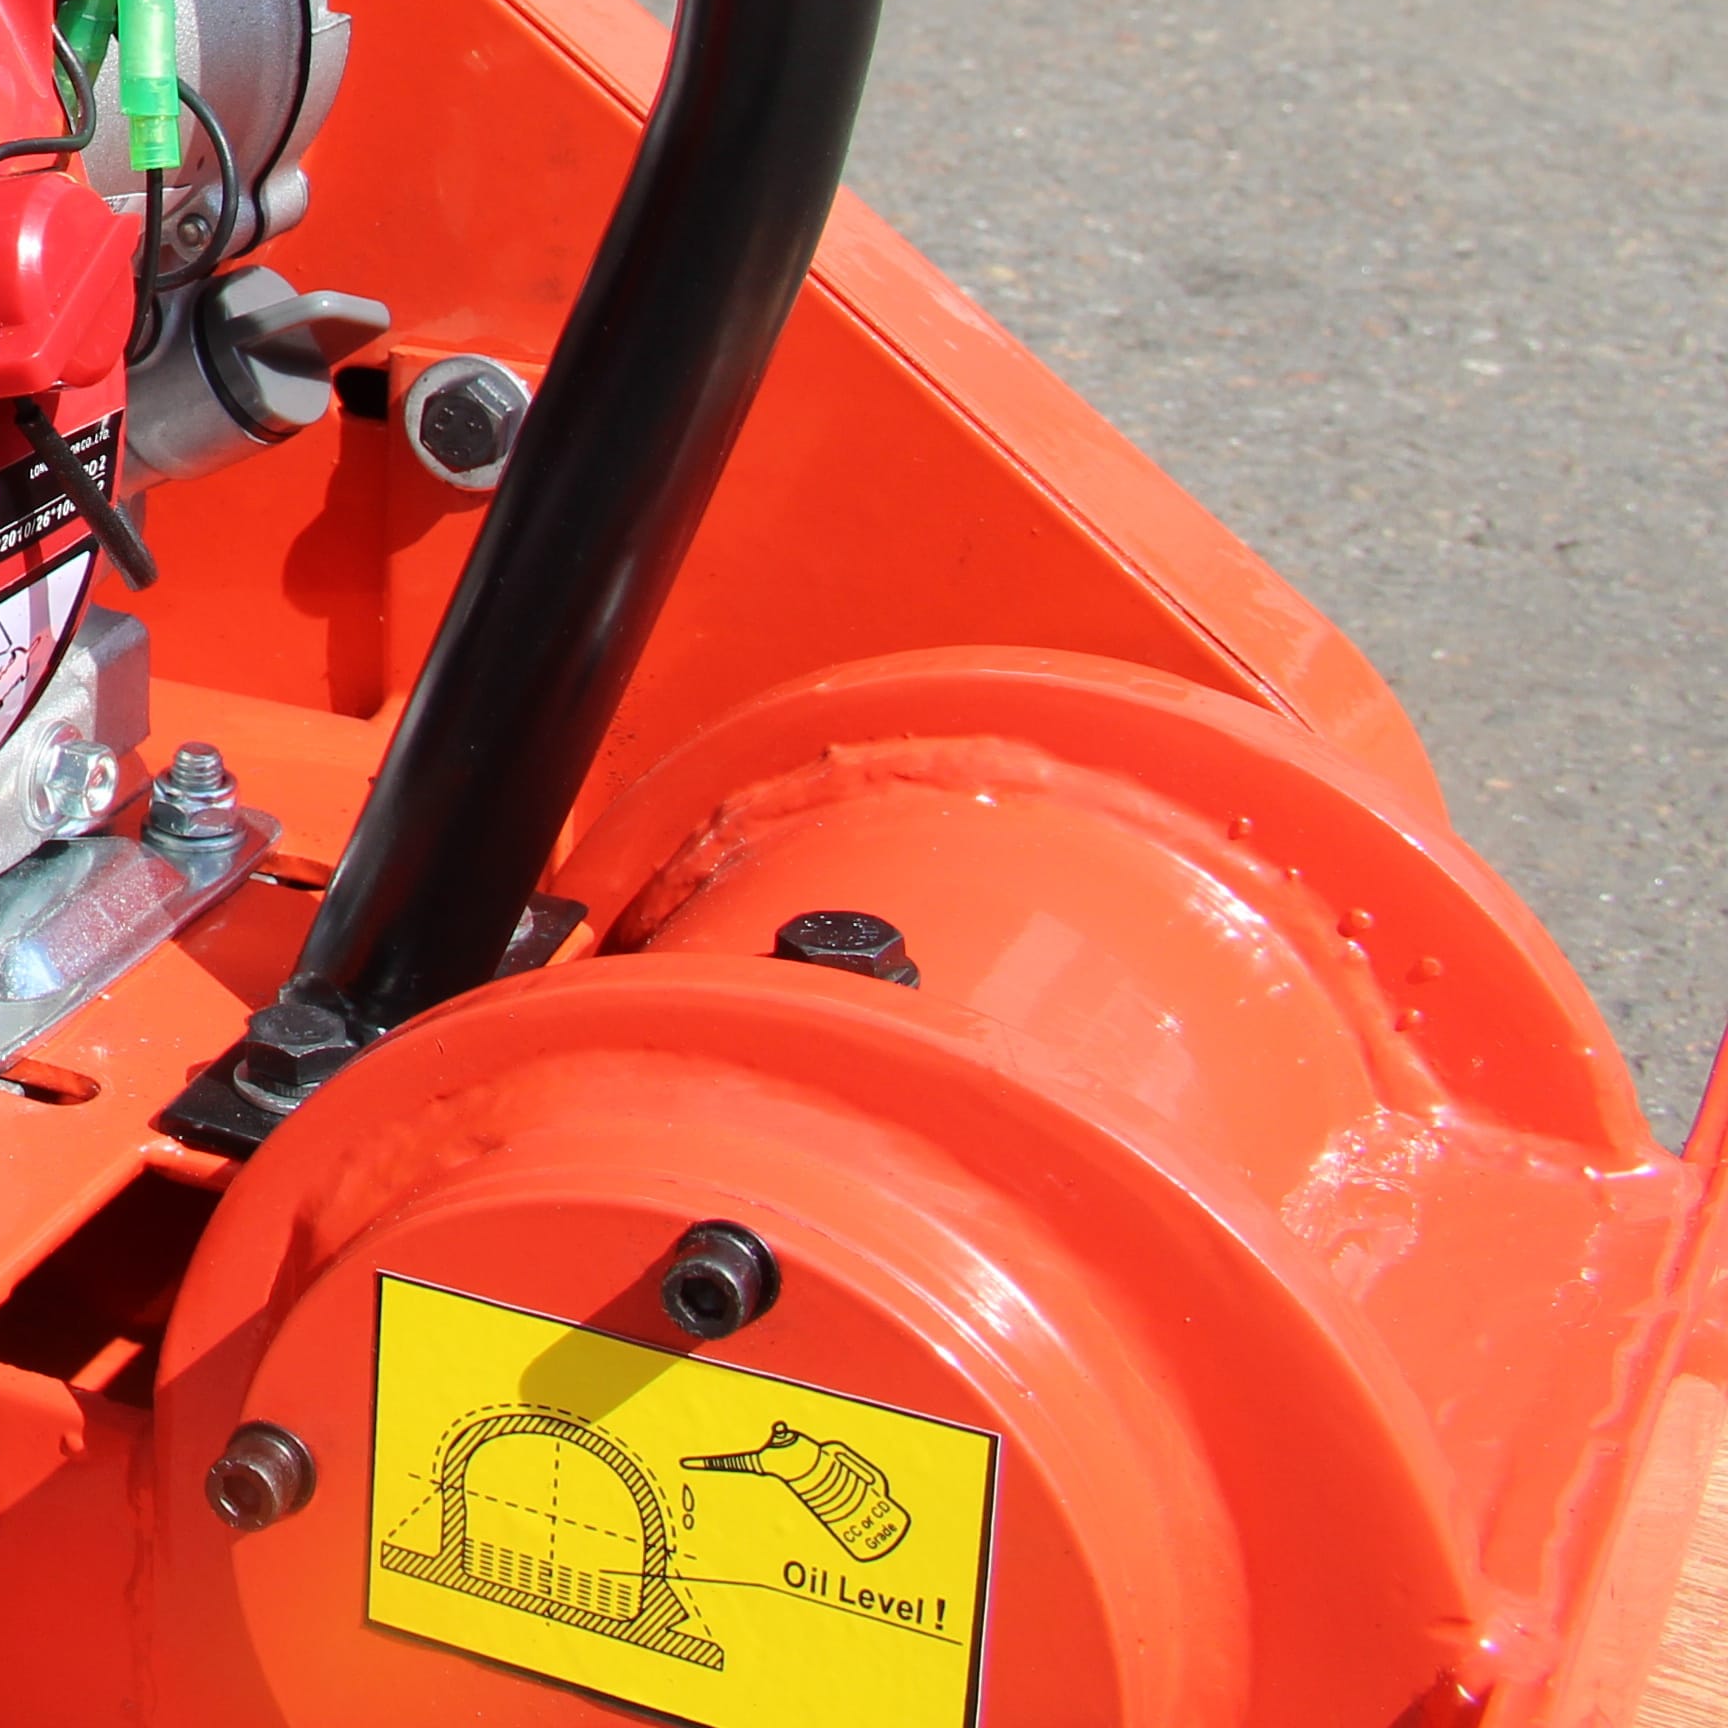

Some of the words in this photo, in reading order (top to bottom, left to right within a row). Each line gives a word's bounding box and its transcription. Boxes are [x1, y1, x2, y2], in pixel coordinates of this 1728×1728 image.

[843, 1524, 863, 1543] CC
[861, 1515, 874, 1529] or
[871, 1500, 891, 1519] CD
[865, 1523, 898, 1550] Grade
[783, 1560, 828, 1597] Oil
[839, 1575, 924, 1625] Level
